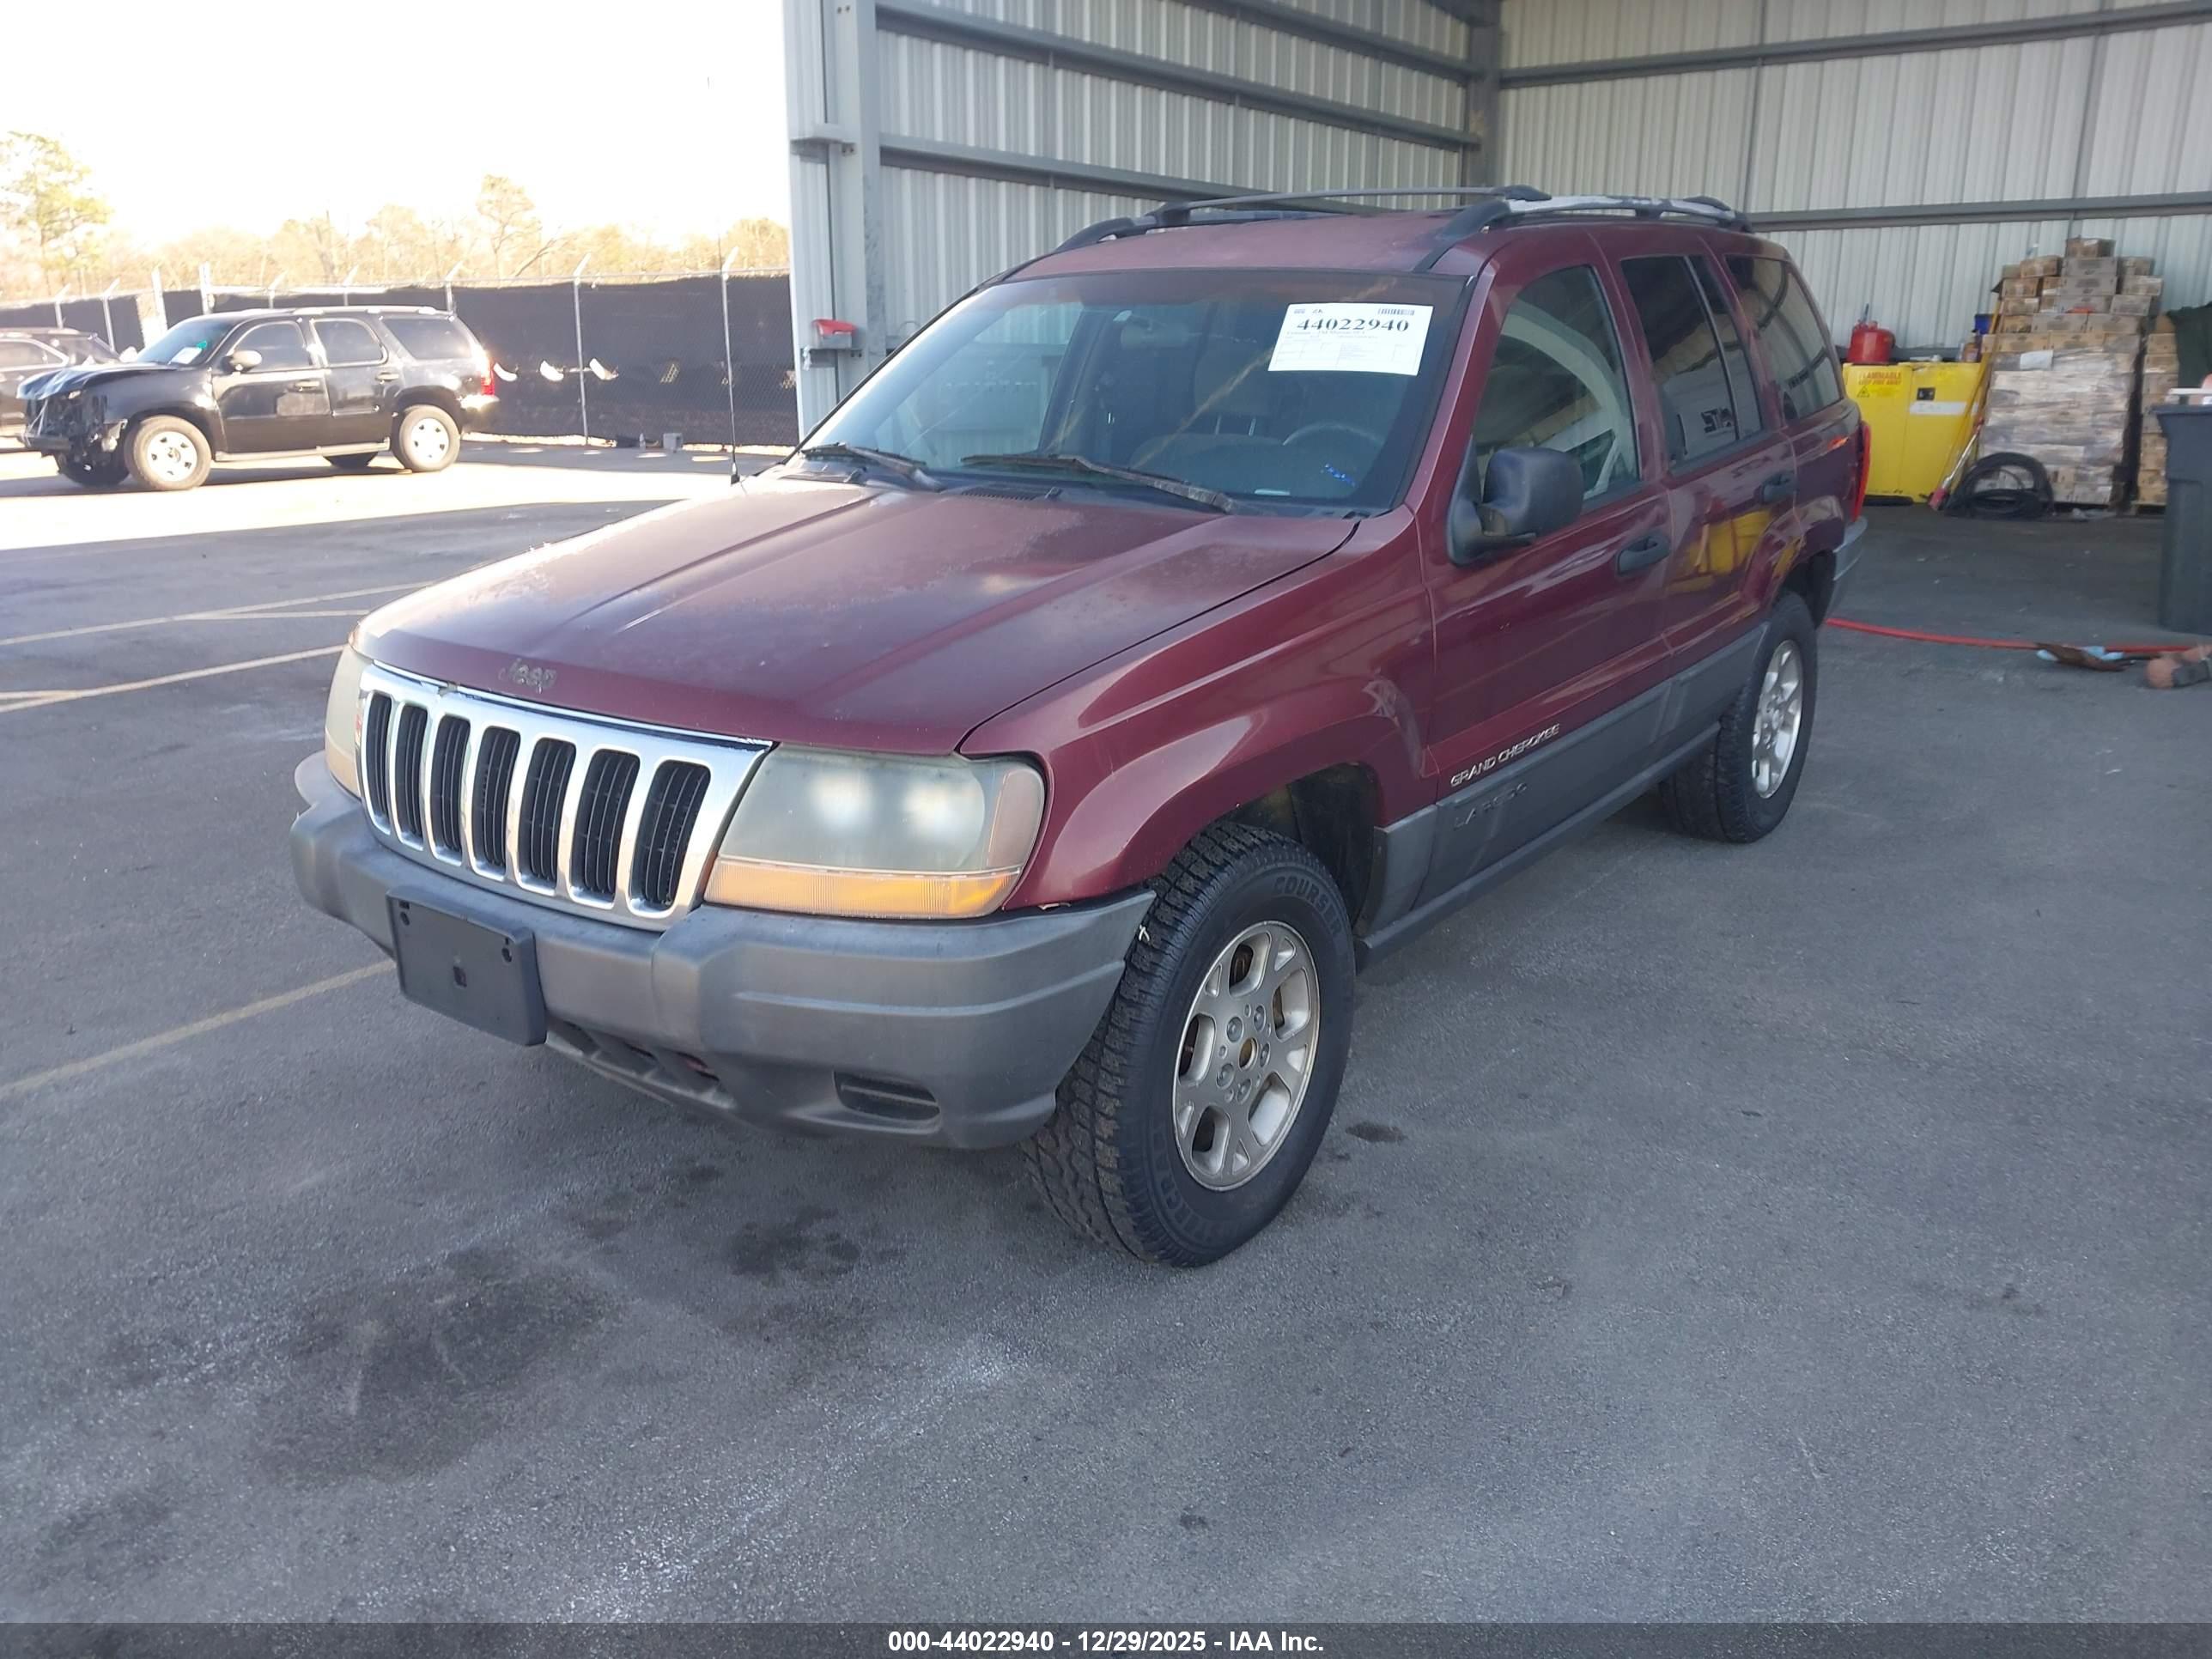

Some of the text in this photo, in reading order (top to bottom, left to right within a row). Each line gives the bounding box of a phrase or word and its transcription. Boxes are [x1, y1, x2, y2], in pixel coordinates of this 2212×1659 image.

[1297, 318, 1410, 332] 44022940
[1450, 723, 1560, 787] GRAND CHEROKEE
